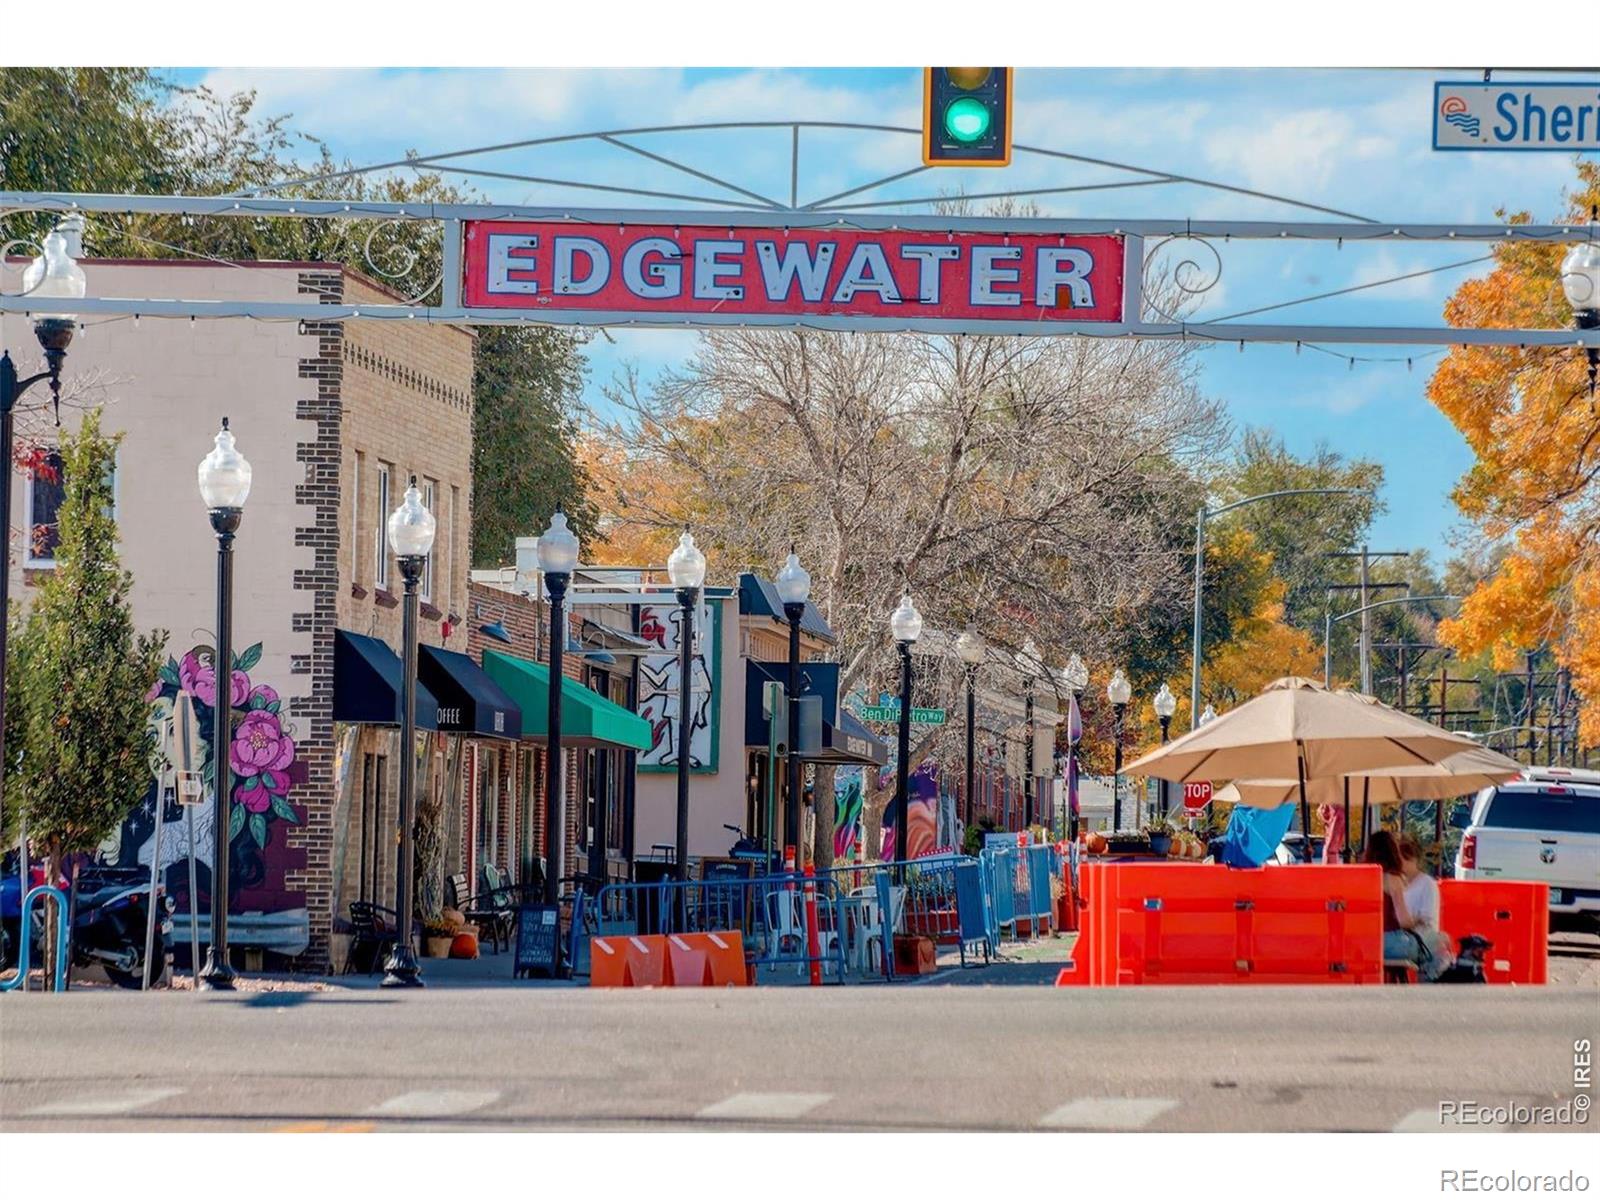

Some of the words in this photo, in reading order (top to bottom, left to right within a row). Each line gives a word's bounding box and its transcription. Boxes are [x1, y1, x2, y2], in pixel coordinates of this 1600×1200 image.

[487, 233, 1096, 310] EDGEWATER
[436, 707, 461, 724] OFFEE
[860, 708, 881, 720] Ben
[884, 708, 927, 722] DiPtro
[927, 712, 944, 722] Way
[1184, 783, 1210, 798] TOP
